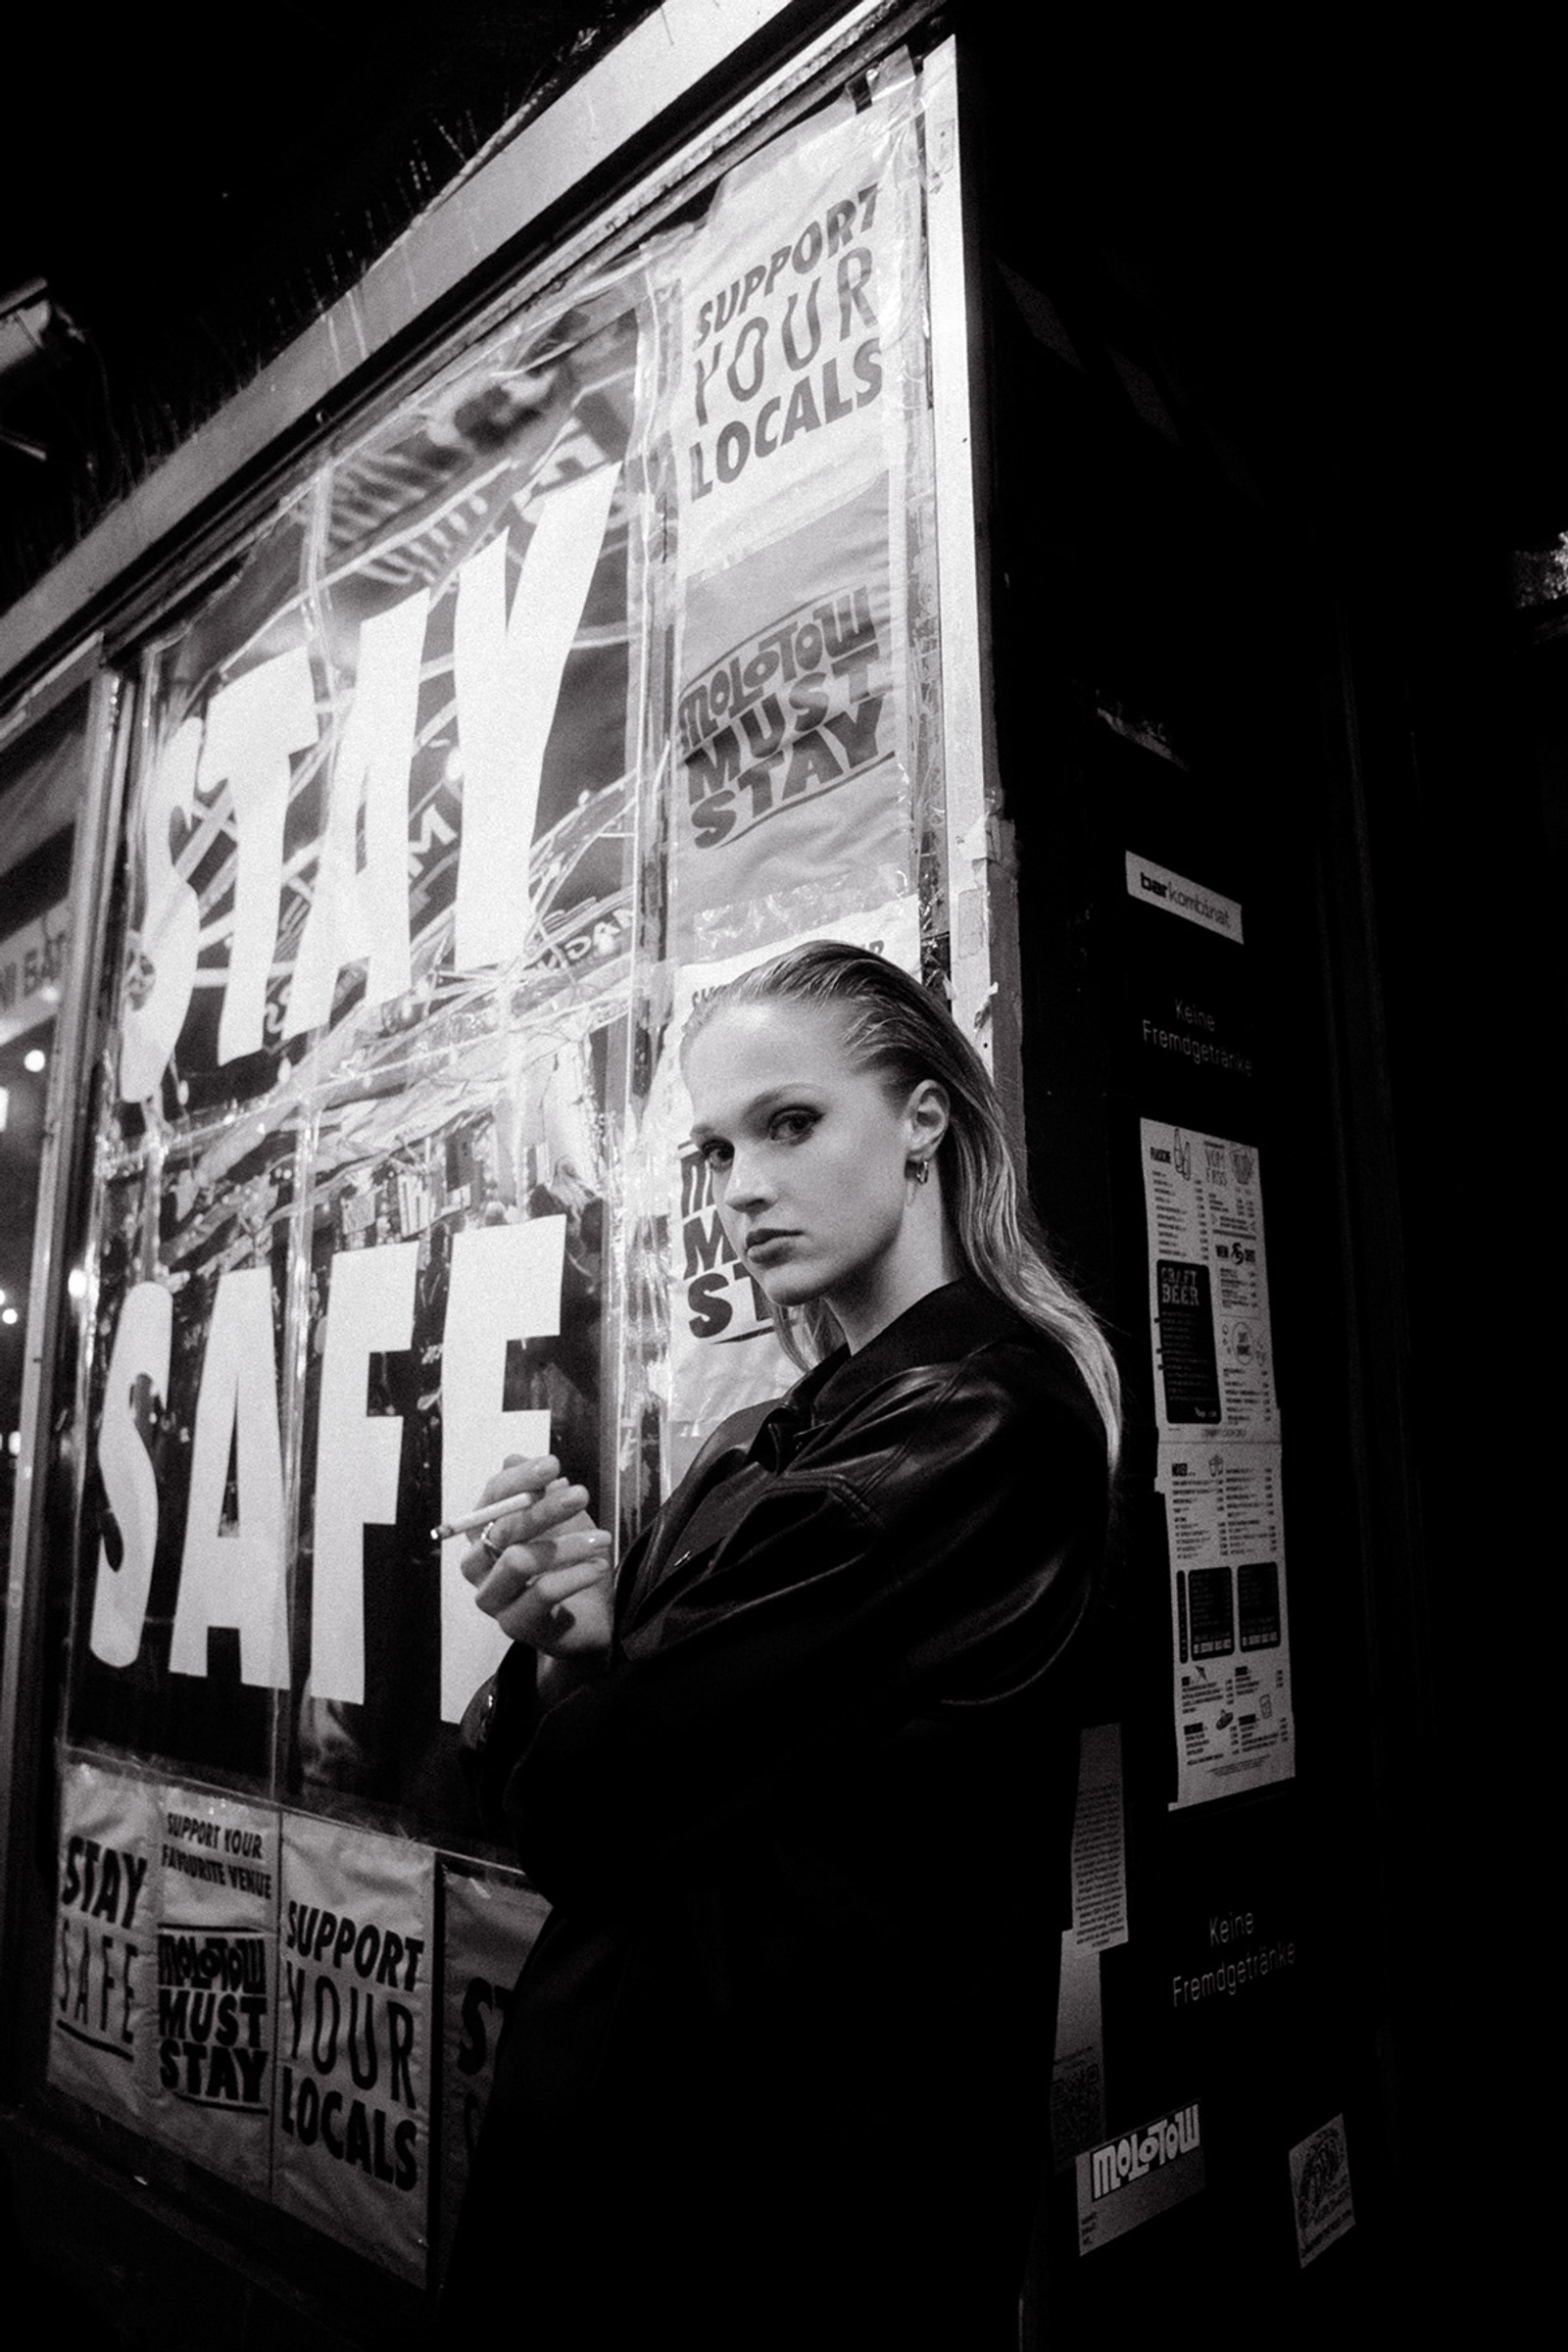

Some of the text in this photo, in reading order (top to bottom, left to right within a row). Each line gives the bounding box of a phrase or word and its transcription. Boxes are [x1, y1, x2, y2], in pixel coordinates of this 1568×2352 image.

[693, 182, 882, 347] SUPPORT
[693, 246, 880, 426] YOUR
[689, 337, 883, 502] LOCALS
[680, 588, 877, 749] MOLOTOW
[684, 641, 881, 804] MUST
[121, 460, 623, 1103] STAY
[691, 696, 885, 850] STAY
[1174, 998, 1215, 1032] Keine
[1161, 1283, 1200, 1306] BEER
[90, 1214, 566, 1725] SAFE
[61, 1836, 147, 1930] STAY
[168, 1812, 263, 1860] SUPPORT YOUR
[230, 1866, 271, 1899] VENUE
[158, 1934, 266, 1996] MOLOTOW
[287, 1900, 425, 1993] SUPPORT
[1172, 1939, 1296, 2008] Fremdgetränke
[1208, 1911, 1254, 1947] Keine
[58, 1919, 138, 2045] SAFE
[159, 1987, 268, 2048] MUST
[159, 2039, 270, 2104] STAY
[287, 1960, 417, 2111] YOUR
[282, 2066, 417, 2192] LOCALS
[1091, 2103, 1201, 2200] MOLOTOW
